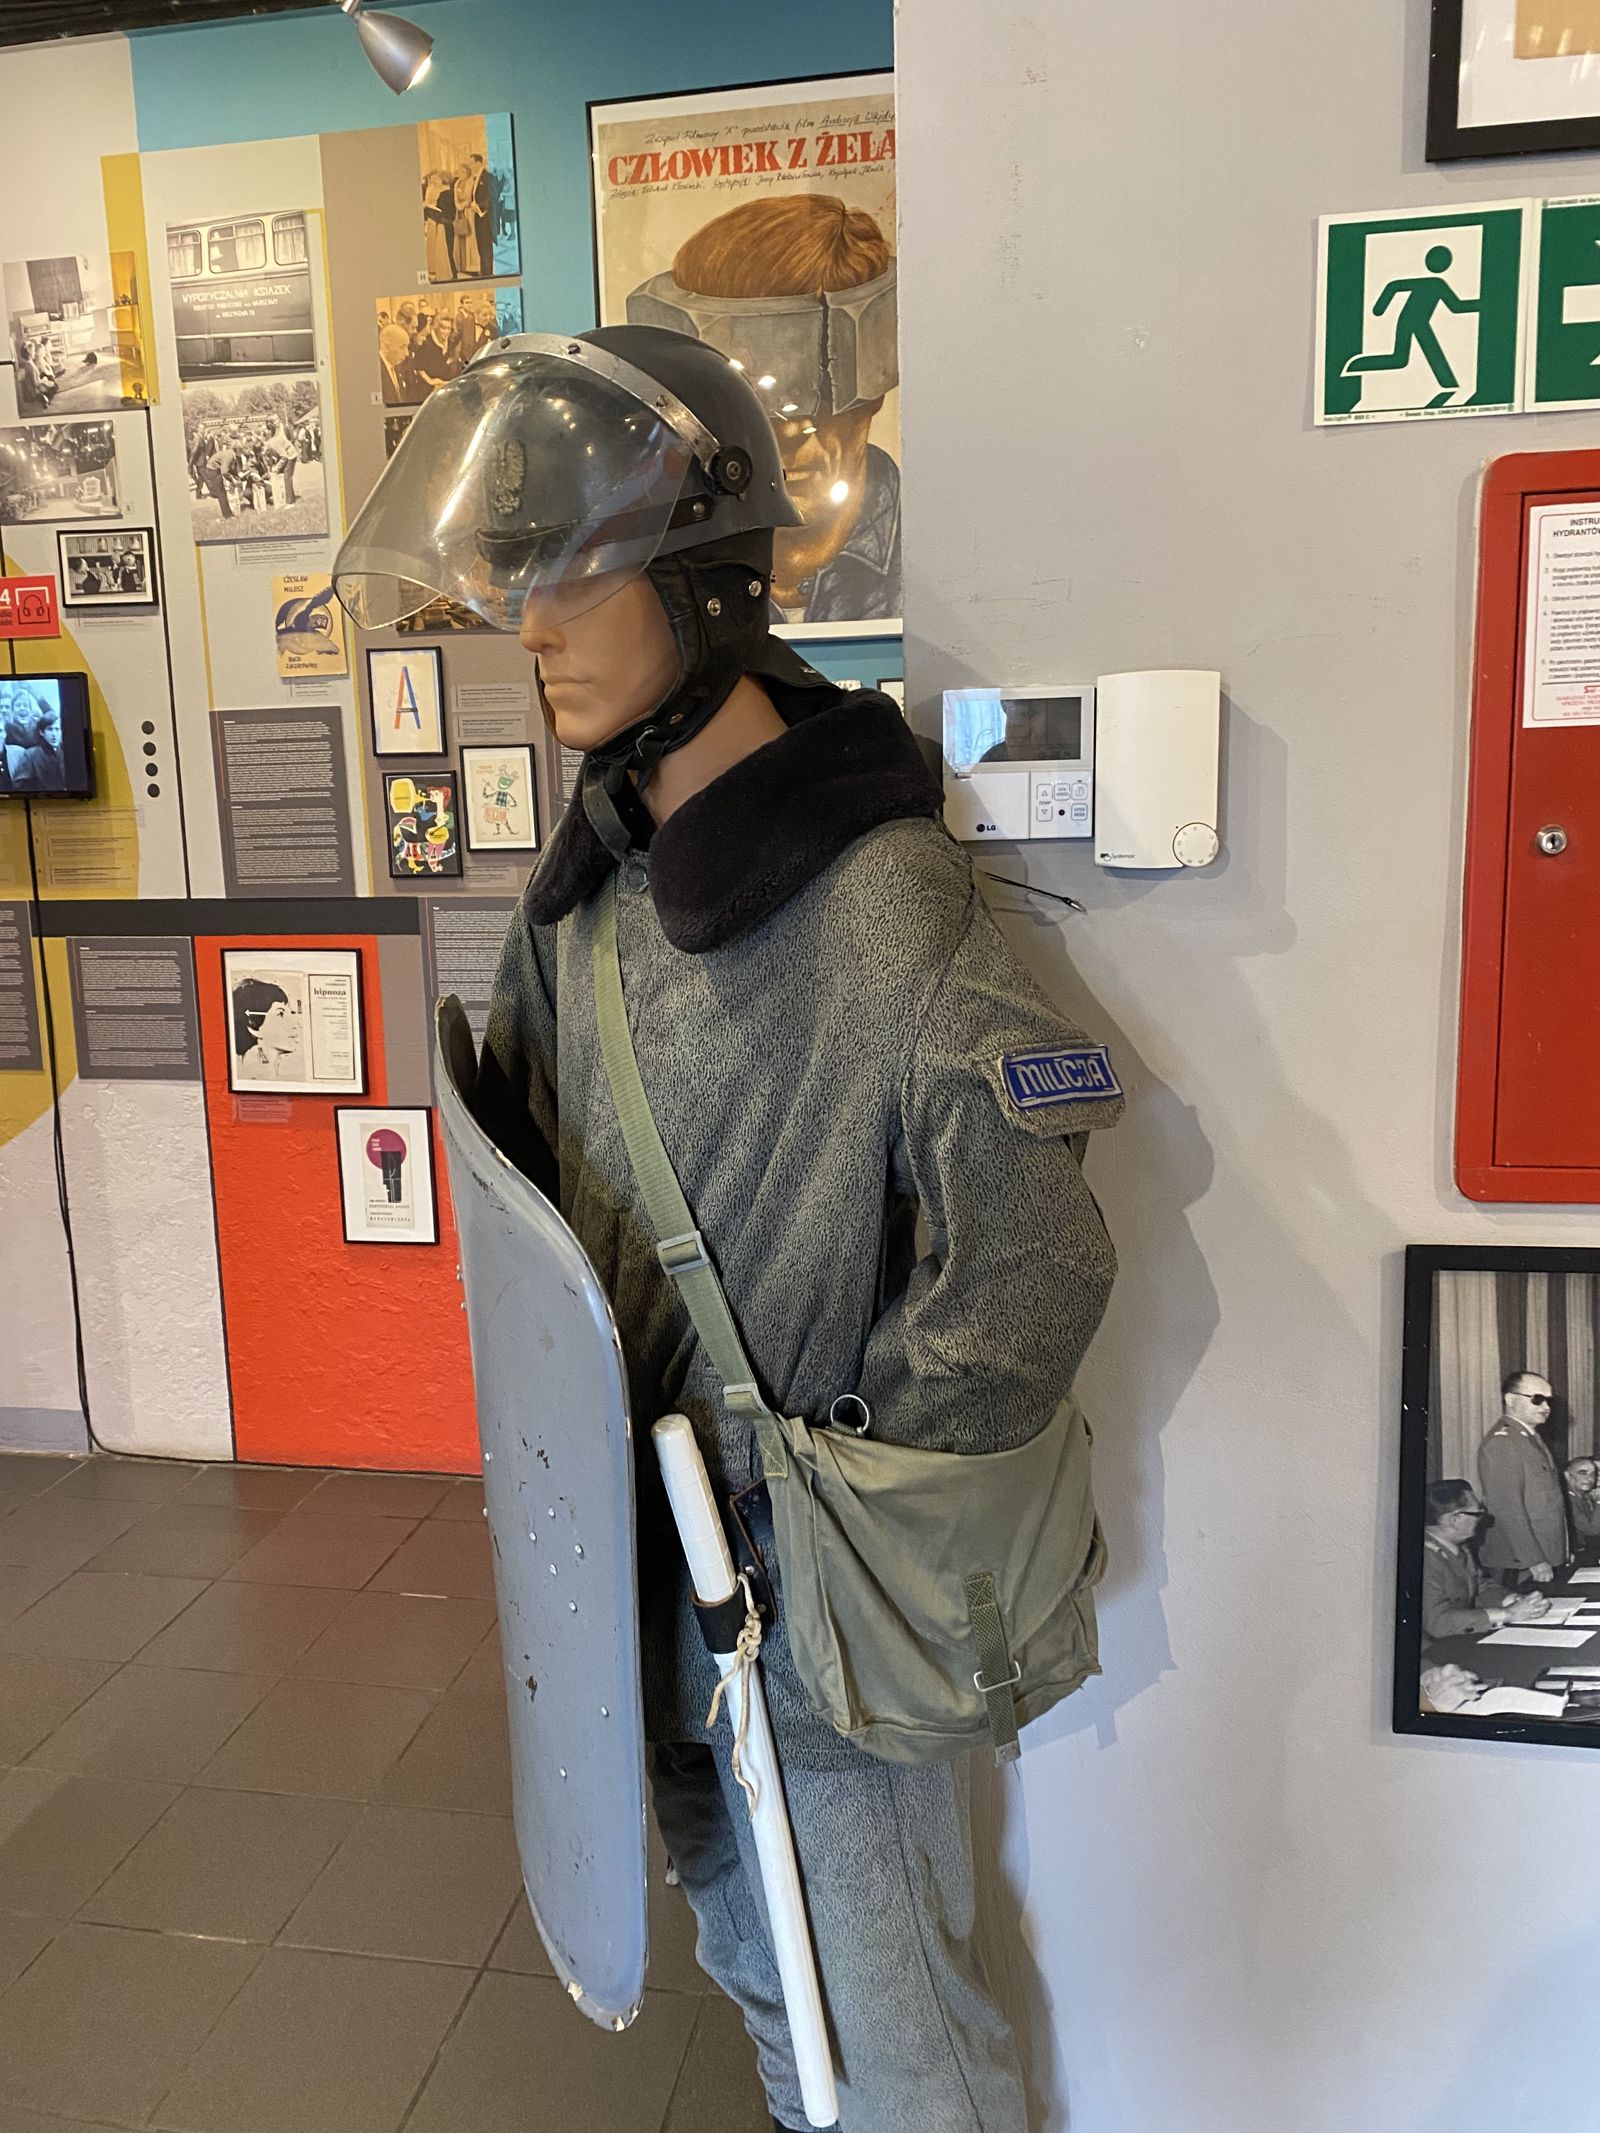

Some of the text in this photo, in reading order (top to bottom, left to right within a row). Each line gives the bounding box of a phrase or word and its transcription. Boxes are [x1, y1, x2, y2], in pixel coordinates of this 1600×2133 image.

[608, 141, 781, 186] CZŁOWIEK
[787, 138, 807, 169] Z
[1552, 527, 1600, 537] HYDRANTÓ
[314, 988, 347, 996] hipnoza
[1014, 1057, 1107, 1095] MILICJA
